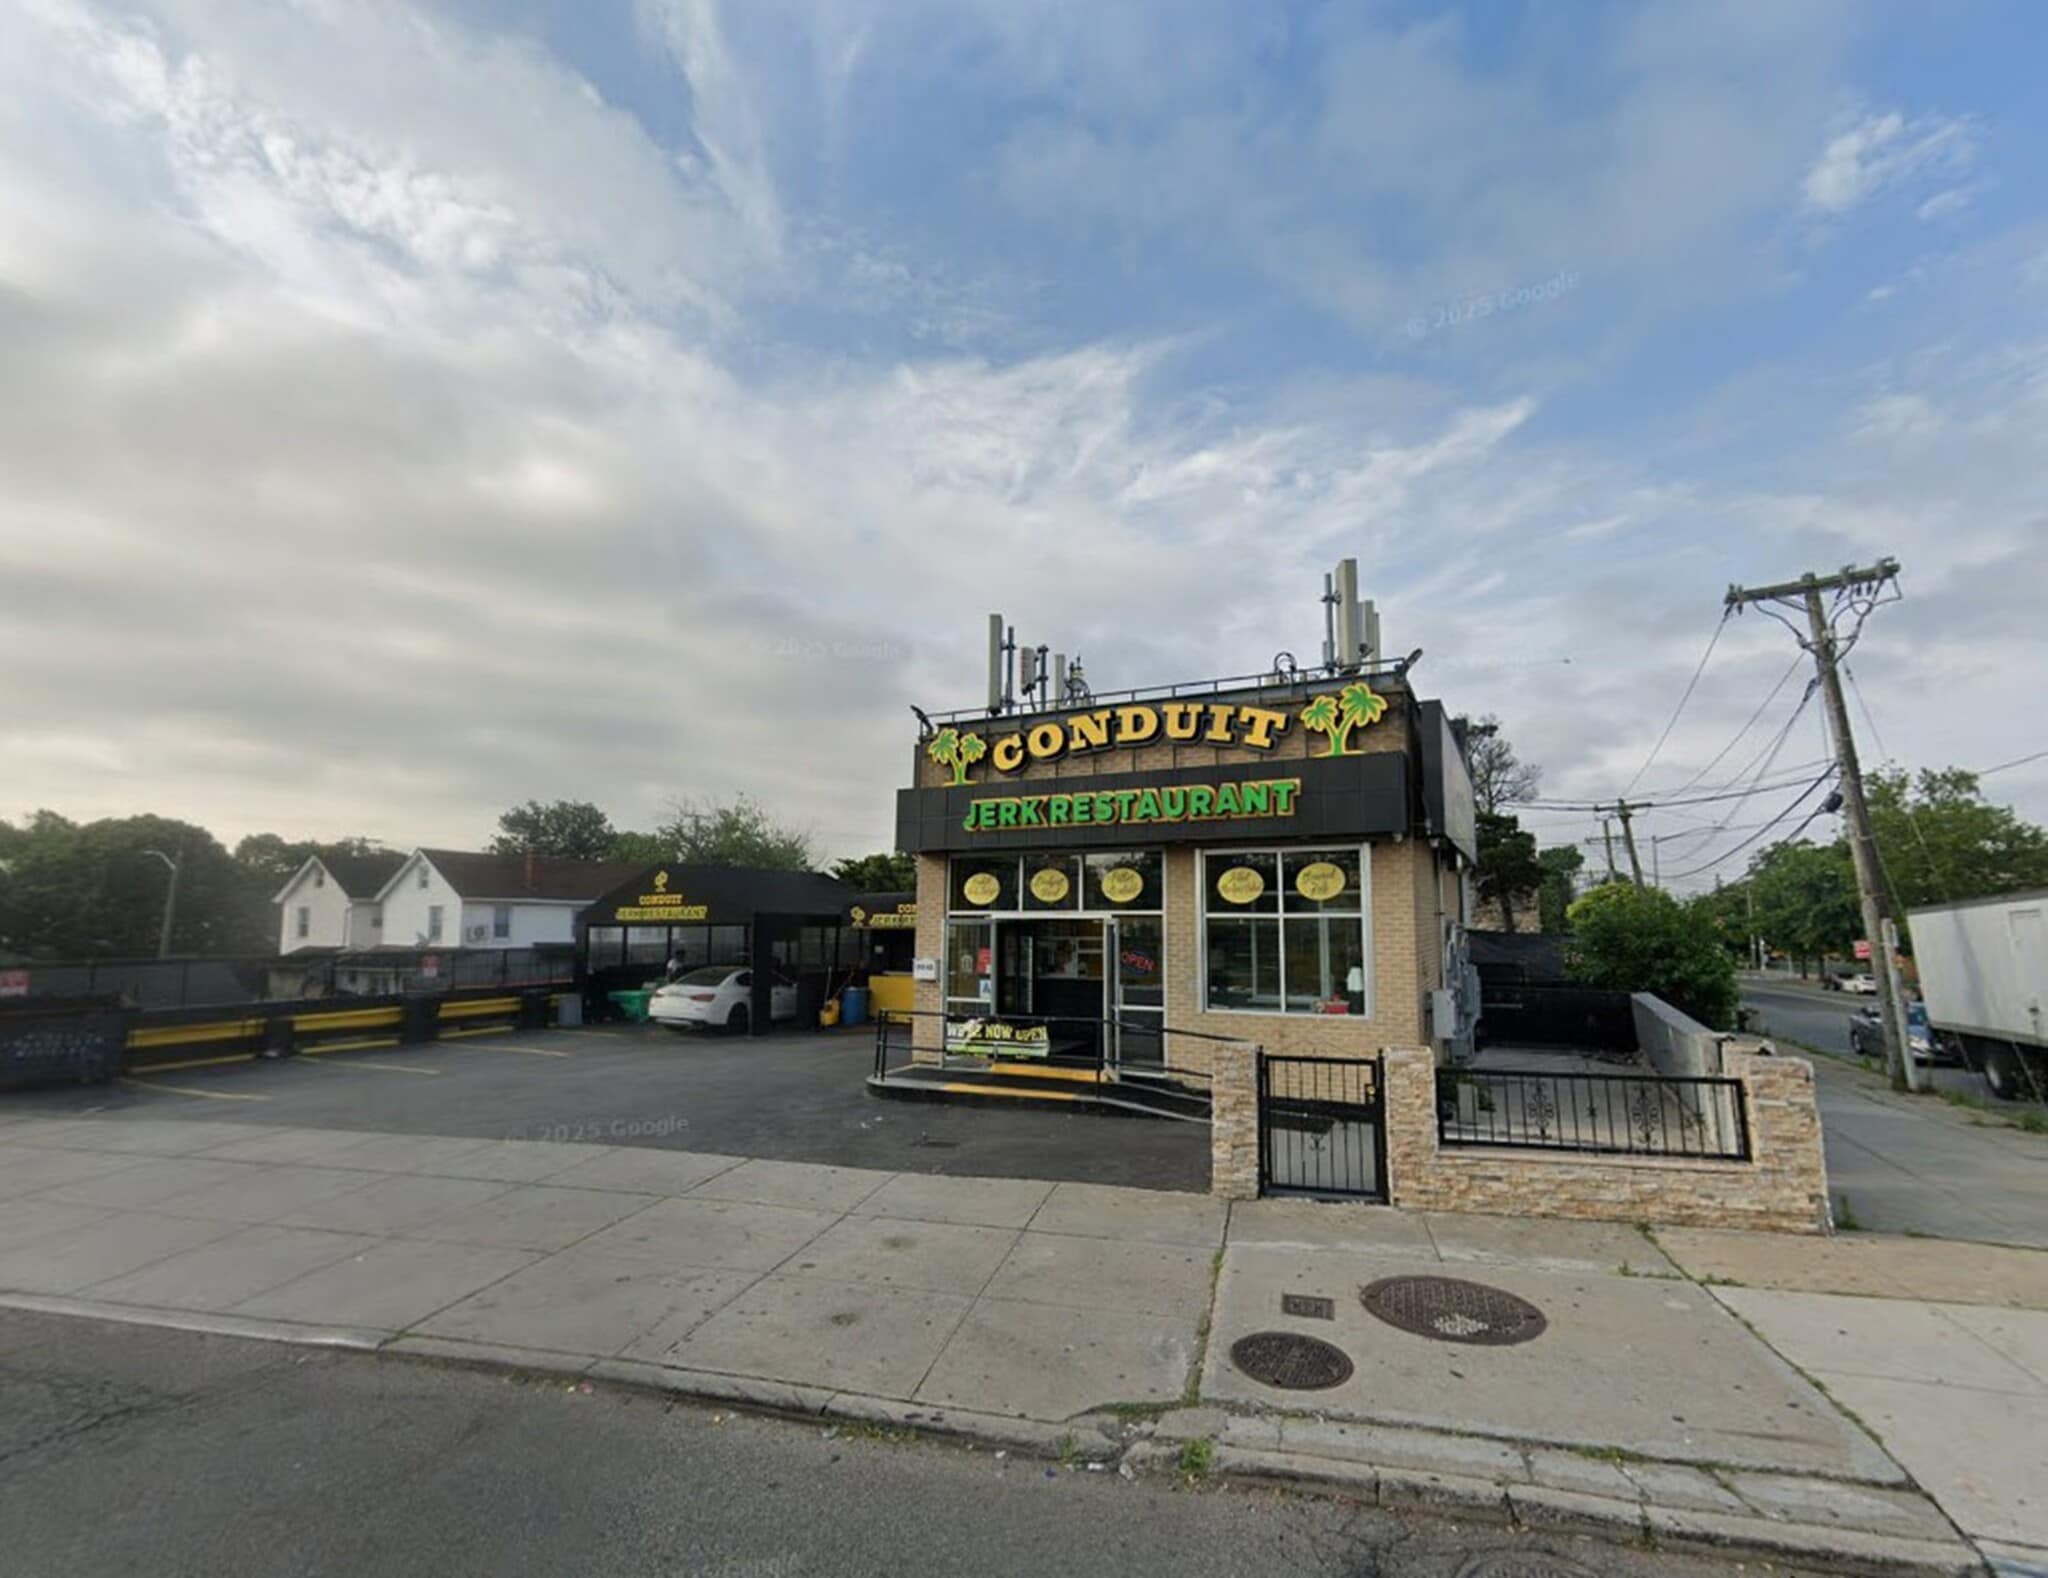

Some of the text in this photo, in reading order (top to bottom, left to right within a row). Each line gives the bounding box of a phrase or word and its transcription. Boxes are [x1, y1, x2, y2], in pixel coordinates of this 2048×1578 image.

[992, 702, 1289, 772] CONDUIT
[962, 777, 1301, 831] JERK RESTAURANT
[1120, 951, 1157, 971] OPEN
[985, 1023, 1013, 1039] NOW
[1015, 1026, 1047, 1041] OPEN
